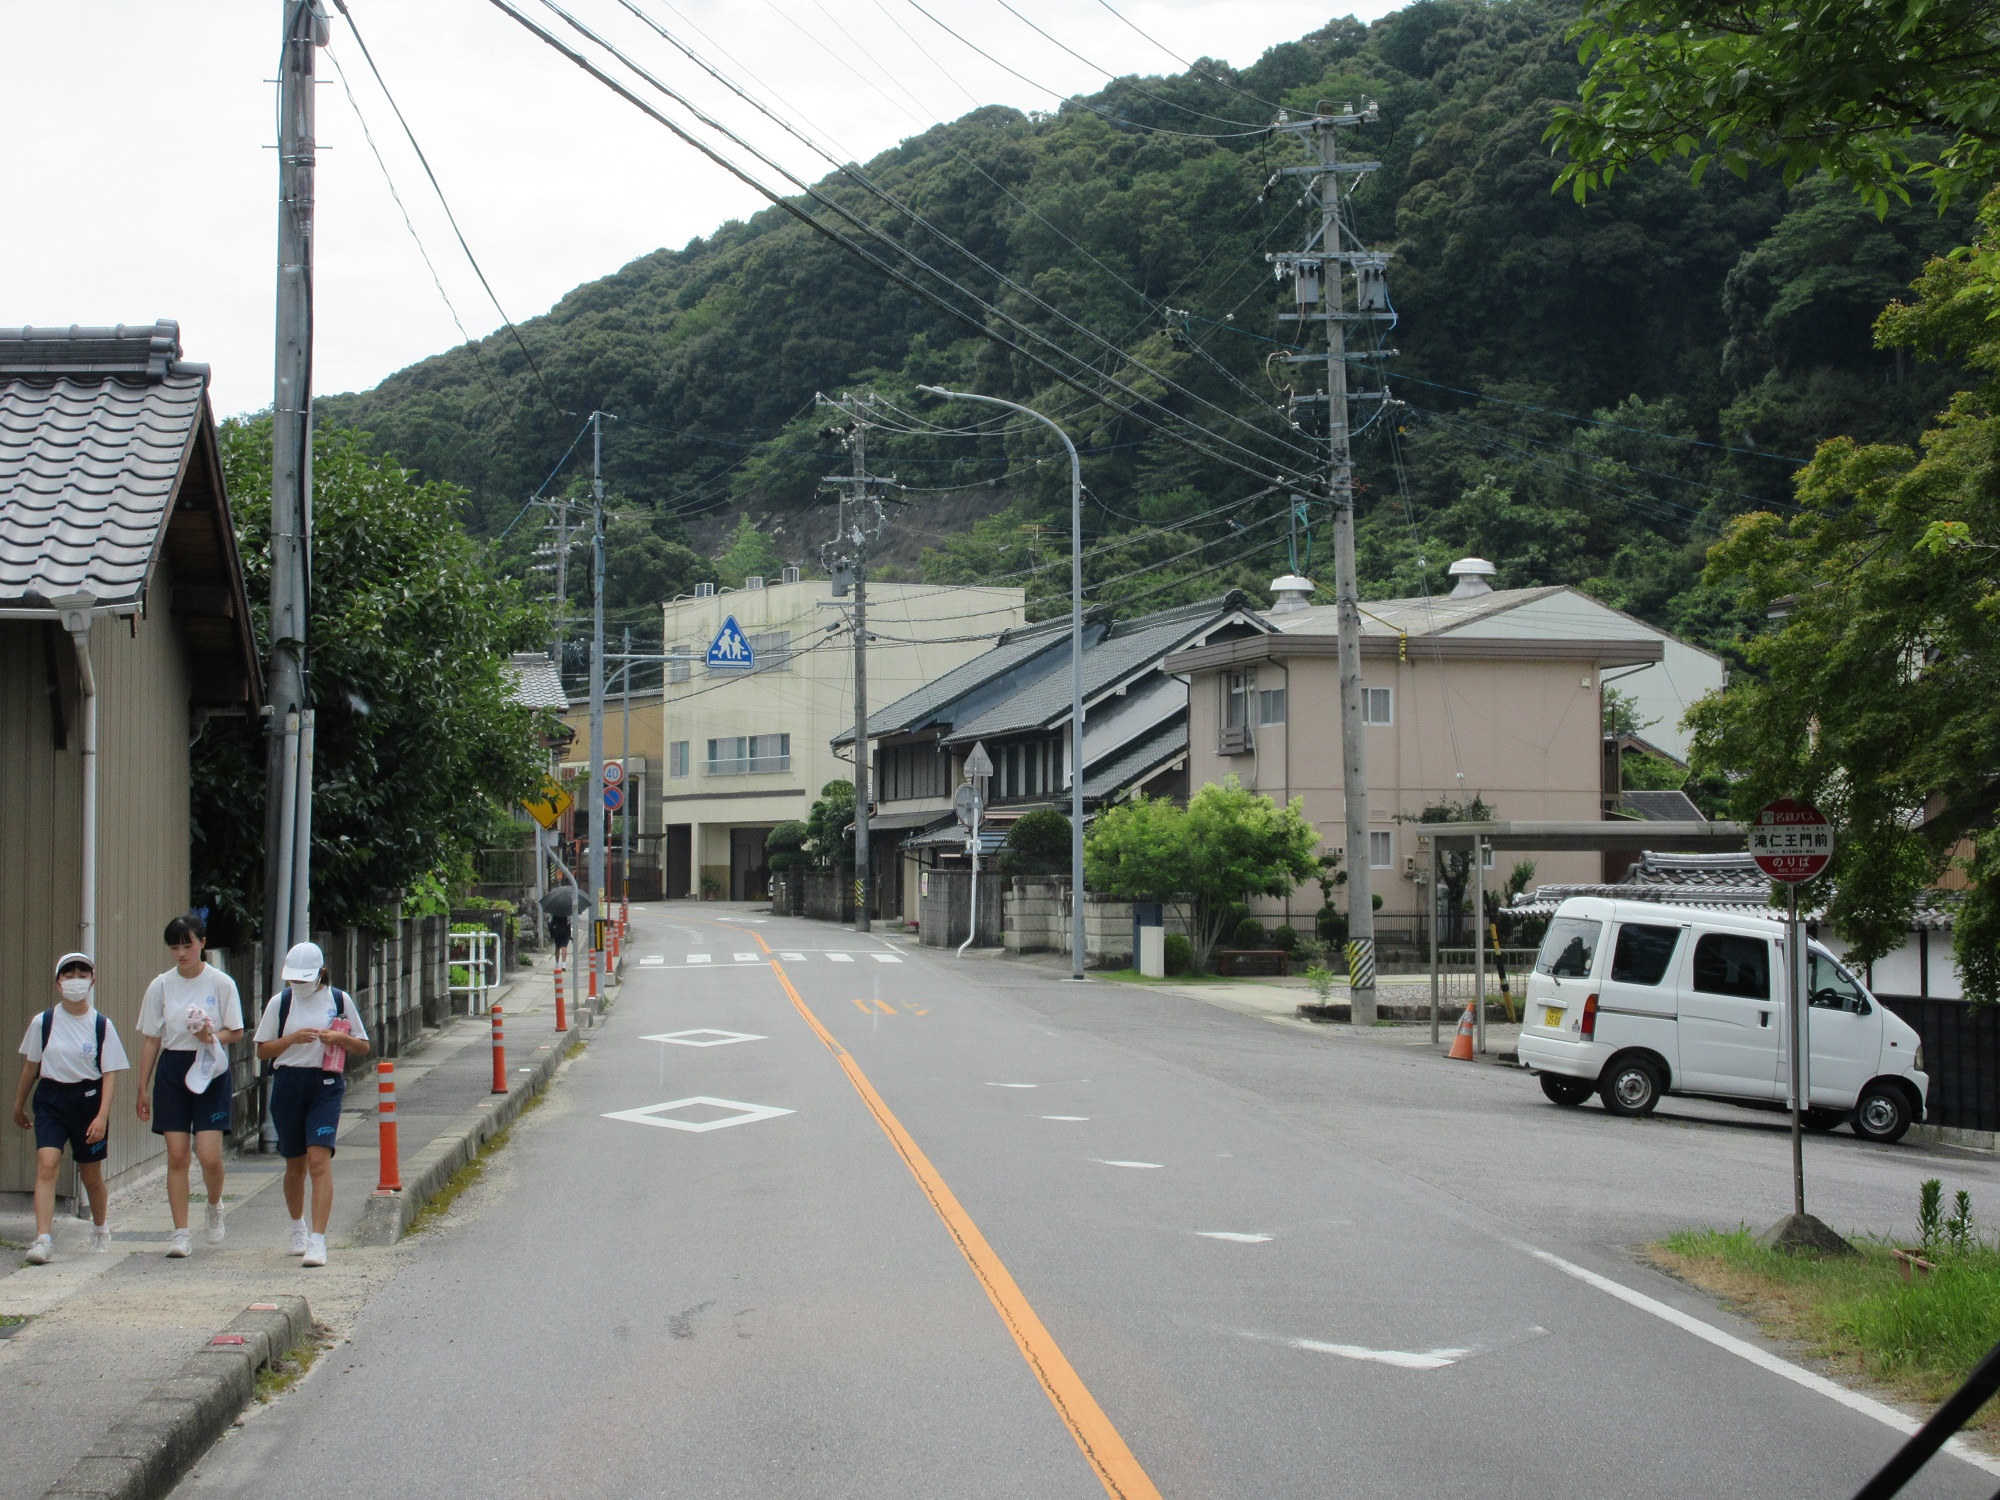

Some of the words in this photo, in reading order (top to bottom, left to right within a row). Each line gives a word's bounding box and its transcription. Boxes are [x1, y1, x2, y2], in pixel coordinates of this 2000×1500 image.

[606, 768, 619, 779] 40
[1775, 812, 1815, 822] 名鉄バス
[1754, 833, 1828, 848] 滝仁王門前
[1772, 856, 1810, 868] のりば
